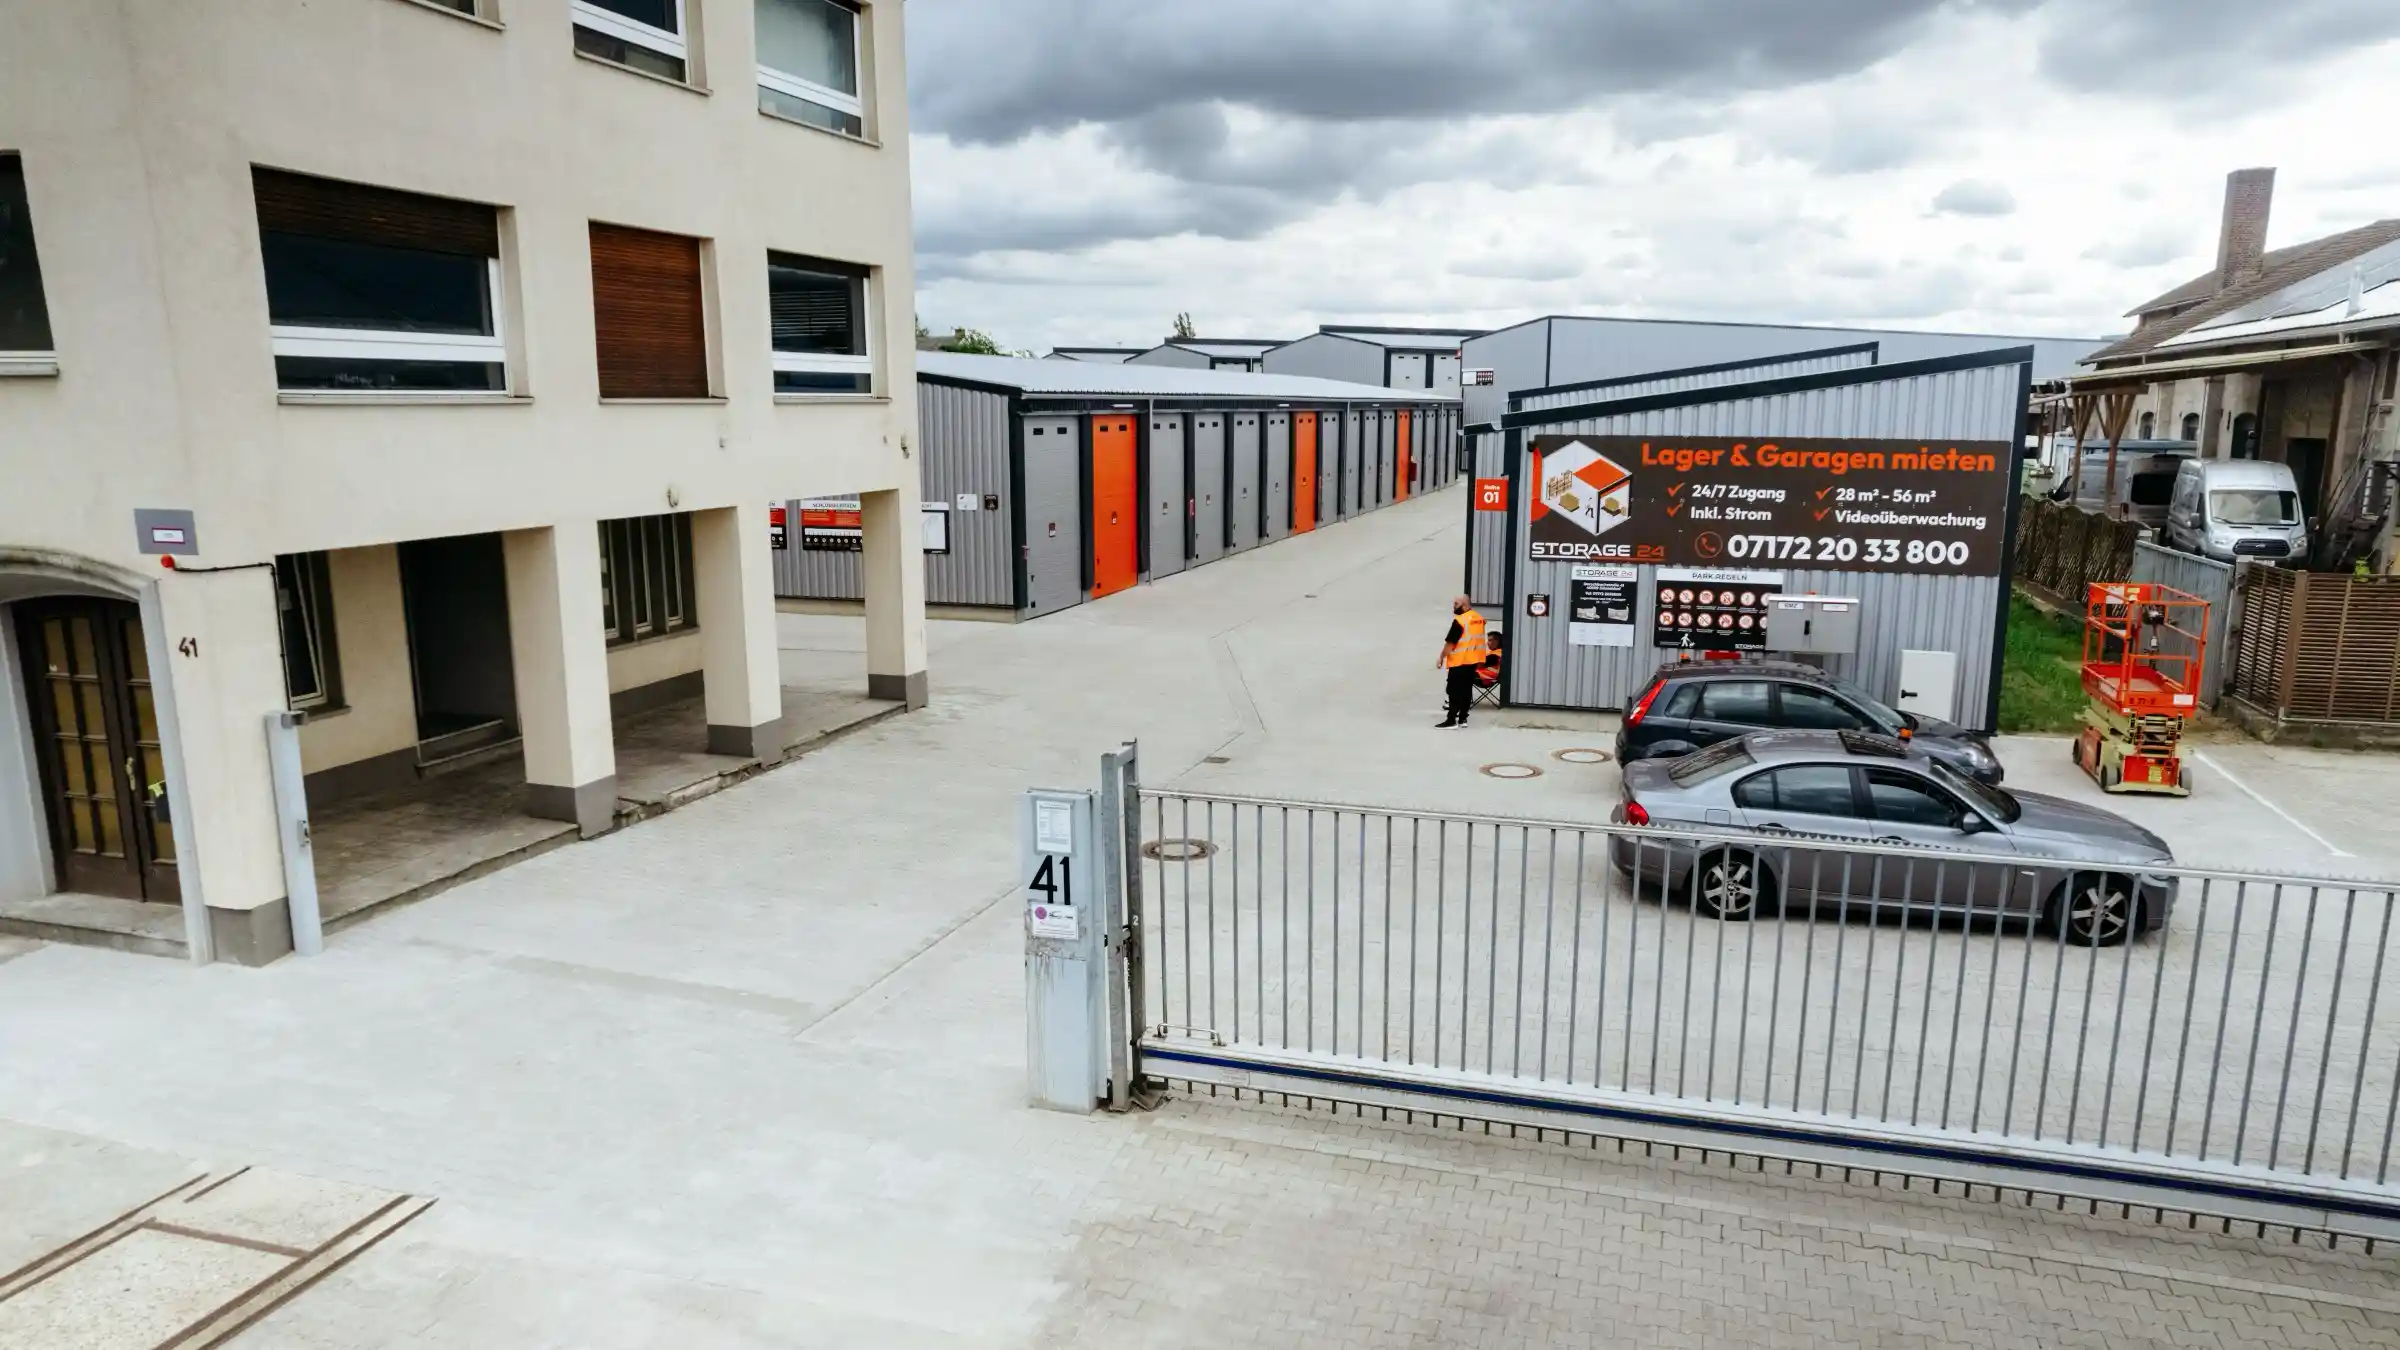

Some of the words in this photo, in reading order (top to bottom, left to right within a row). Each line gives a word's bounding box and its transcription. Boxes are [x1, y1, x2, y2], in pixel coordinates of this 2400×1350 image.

[1641, 442, 1725, 471] Lager
[1730, 443, 1752, 467] &
[1756, 444, 1885, 475] Garagen
[1891, 446, 1996, 472] mieten
[1483, 491, 1500, 504] 01
[1691, 484, 1725, 499] 24/7
[1728, 485, 1786, 503] Zugang
[1835, 488, 1856, 501] 28
[1858, 488, 1880, 502] m²
[1892, 489, 1913, 503] 56
[1915, 490, 1937, 503] m²
[1690, 506, 1722, 520] Inkl.
[1725, 507, 1772, 521] Strom
[1834, 509, 1987, 530] Videoüberwachung
[1531, 541, 1631, 559] STORAGE
[1636, 544, 1666, 557] 24
[1727, 534, 1812, 560] 07172
[1816, 537, 1857, 562] 20
[1862, 538, 1901, 563] 33
[1905, 539, 1969, 566] 800
[1575, 569, 1618, 577] STORAGE
[178, 637, 198, 658] 41
[1029, 855, 1072, 906] 41
[1133, 915, 1139, 926] 2
